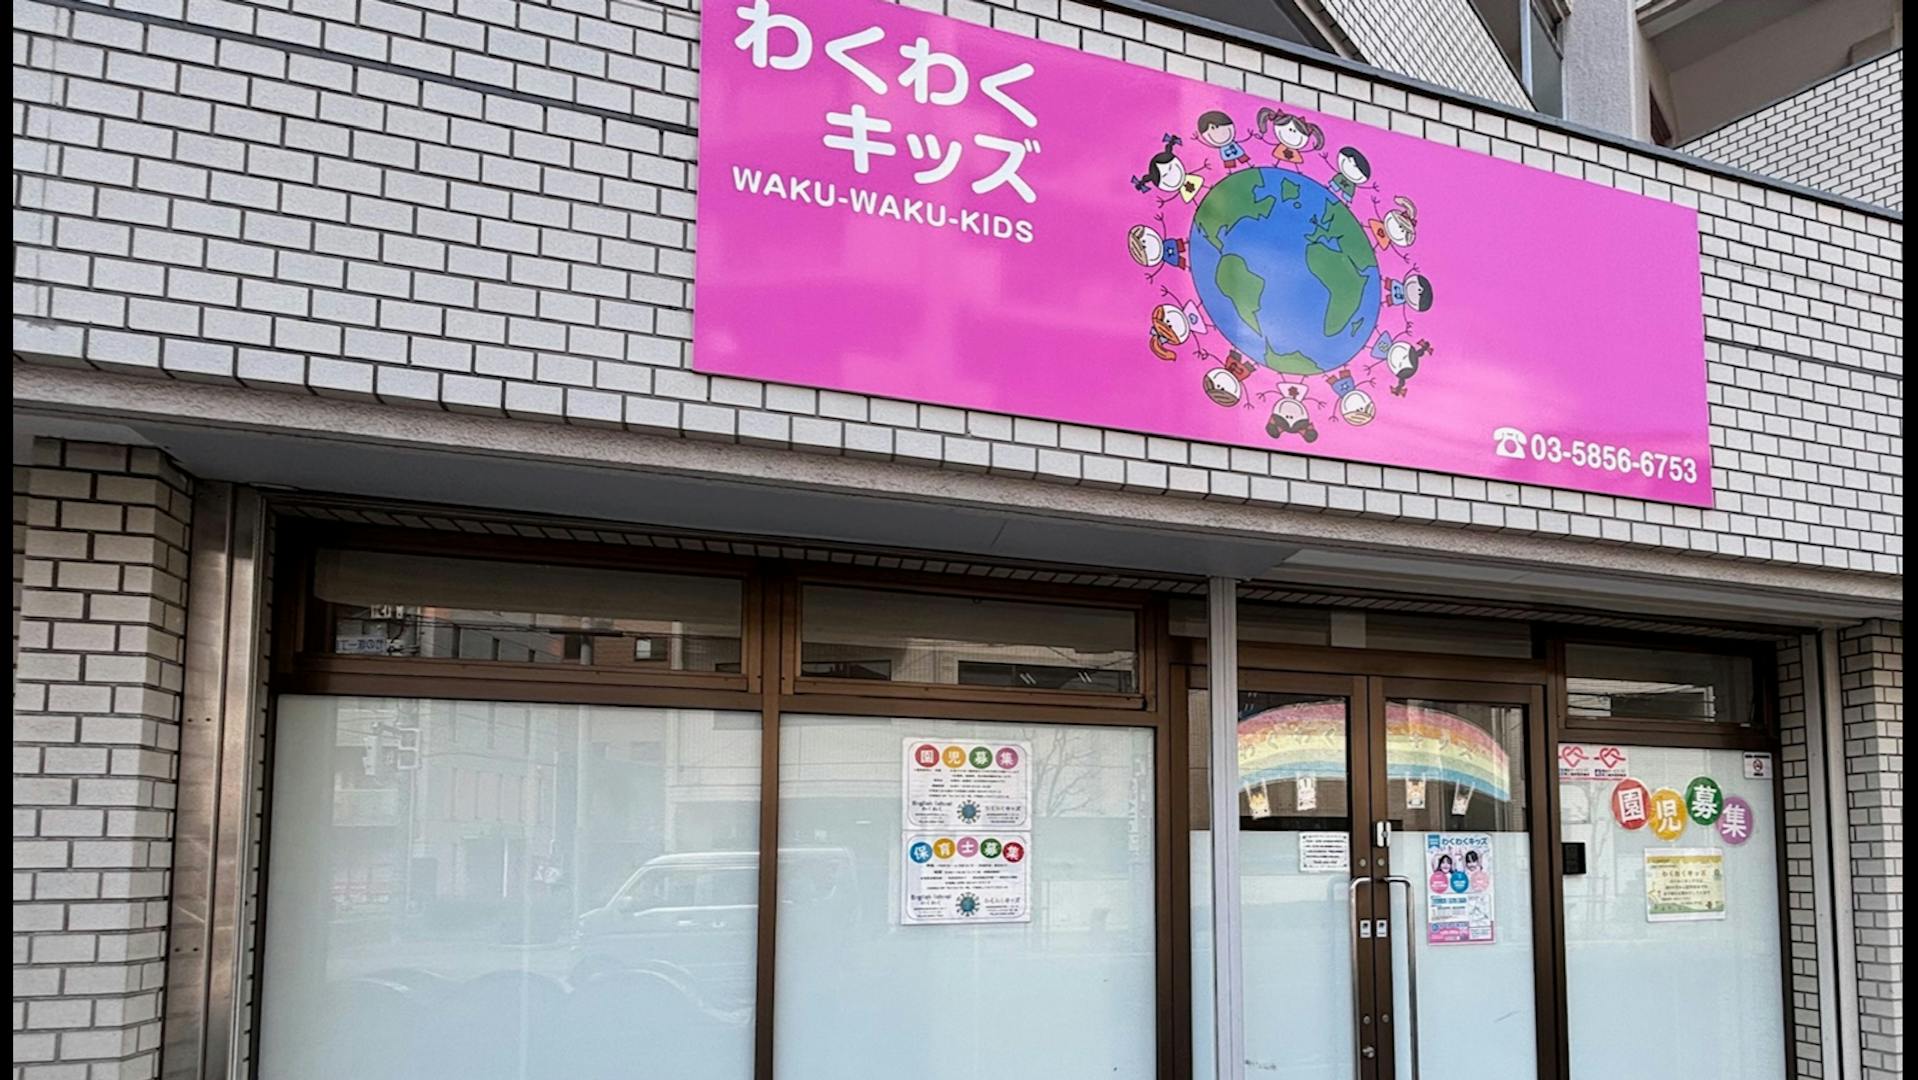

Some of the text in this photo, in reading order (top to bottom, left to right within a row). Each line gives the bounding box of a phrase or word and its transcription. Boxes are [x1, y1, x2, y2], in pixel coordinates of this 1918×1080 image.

[735, 0, 1038, 128] わくわく
[823, 104, 1041, 204] キッズ
[731, 165, 1035, 244] WAKU-WAKU-KIDS
[1530, 433, 1698, 484] 03-5856-6753
[920, 749, 1015, 766] 園児募集
[1618, 784, 1748, 840] 園児募集
[914, 841, 1021, 860] 保育士募集
[1442, 837, 1489, 846] わくわくキッズ
